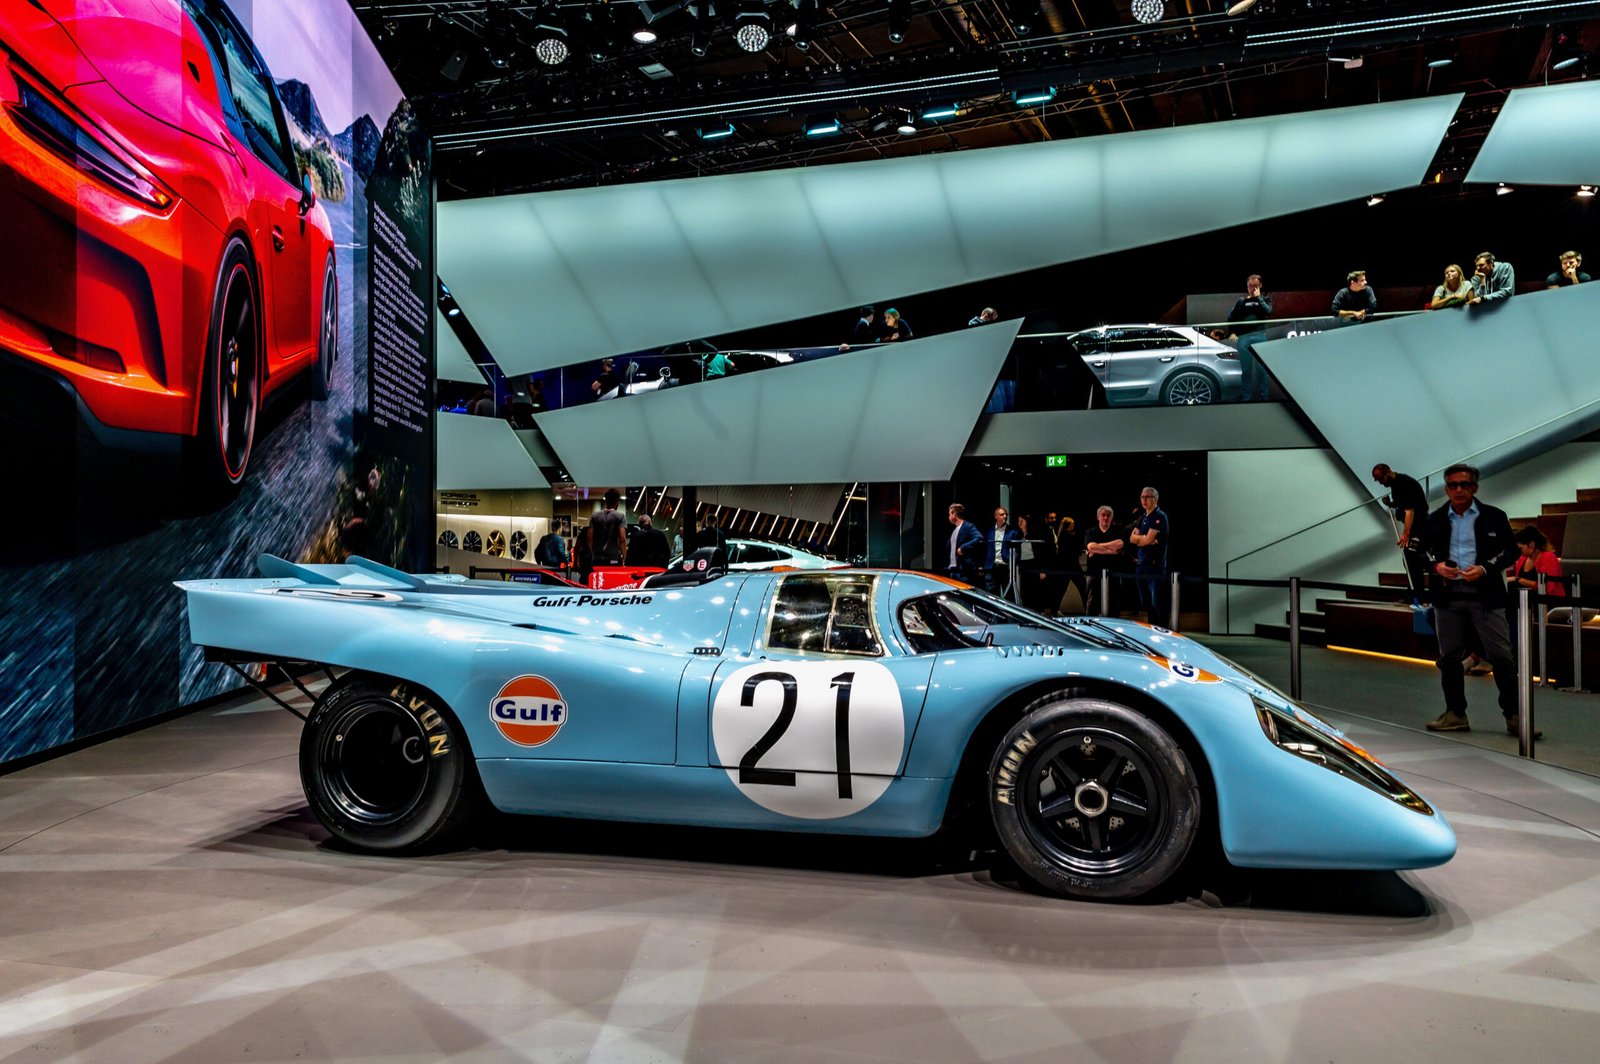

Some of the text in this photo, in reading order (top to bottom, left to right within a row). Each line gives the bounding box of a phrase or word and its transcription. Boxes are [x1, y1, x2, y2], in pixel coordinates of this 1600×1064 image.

[533, 595, 653, 607] Gulf-Porsche
[390, 684, 450, 756] AVON
[495, 700, 563, 722] Gulf
[739, 671, 855, 800] 21
[997, 729, 1038, 806] AVON
